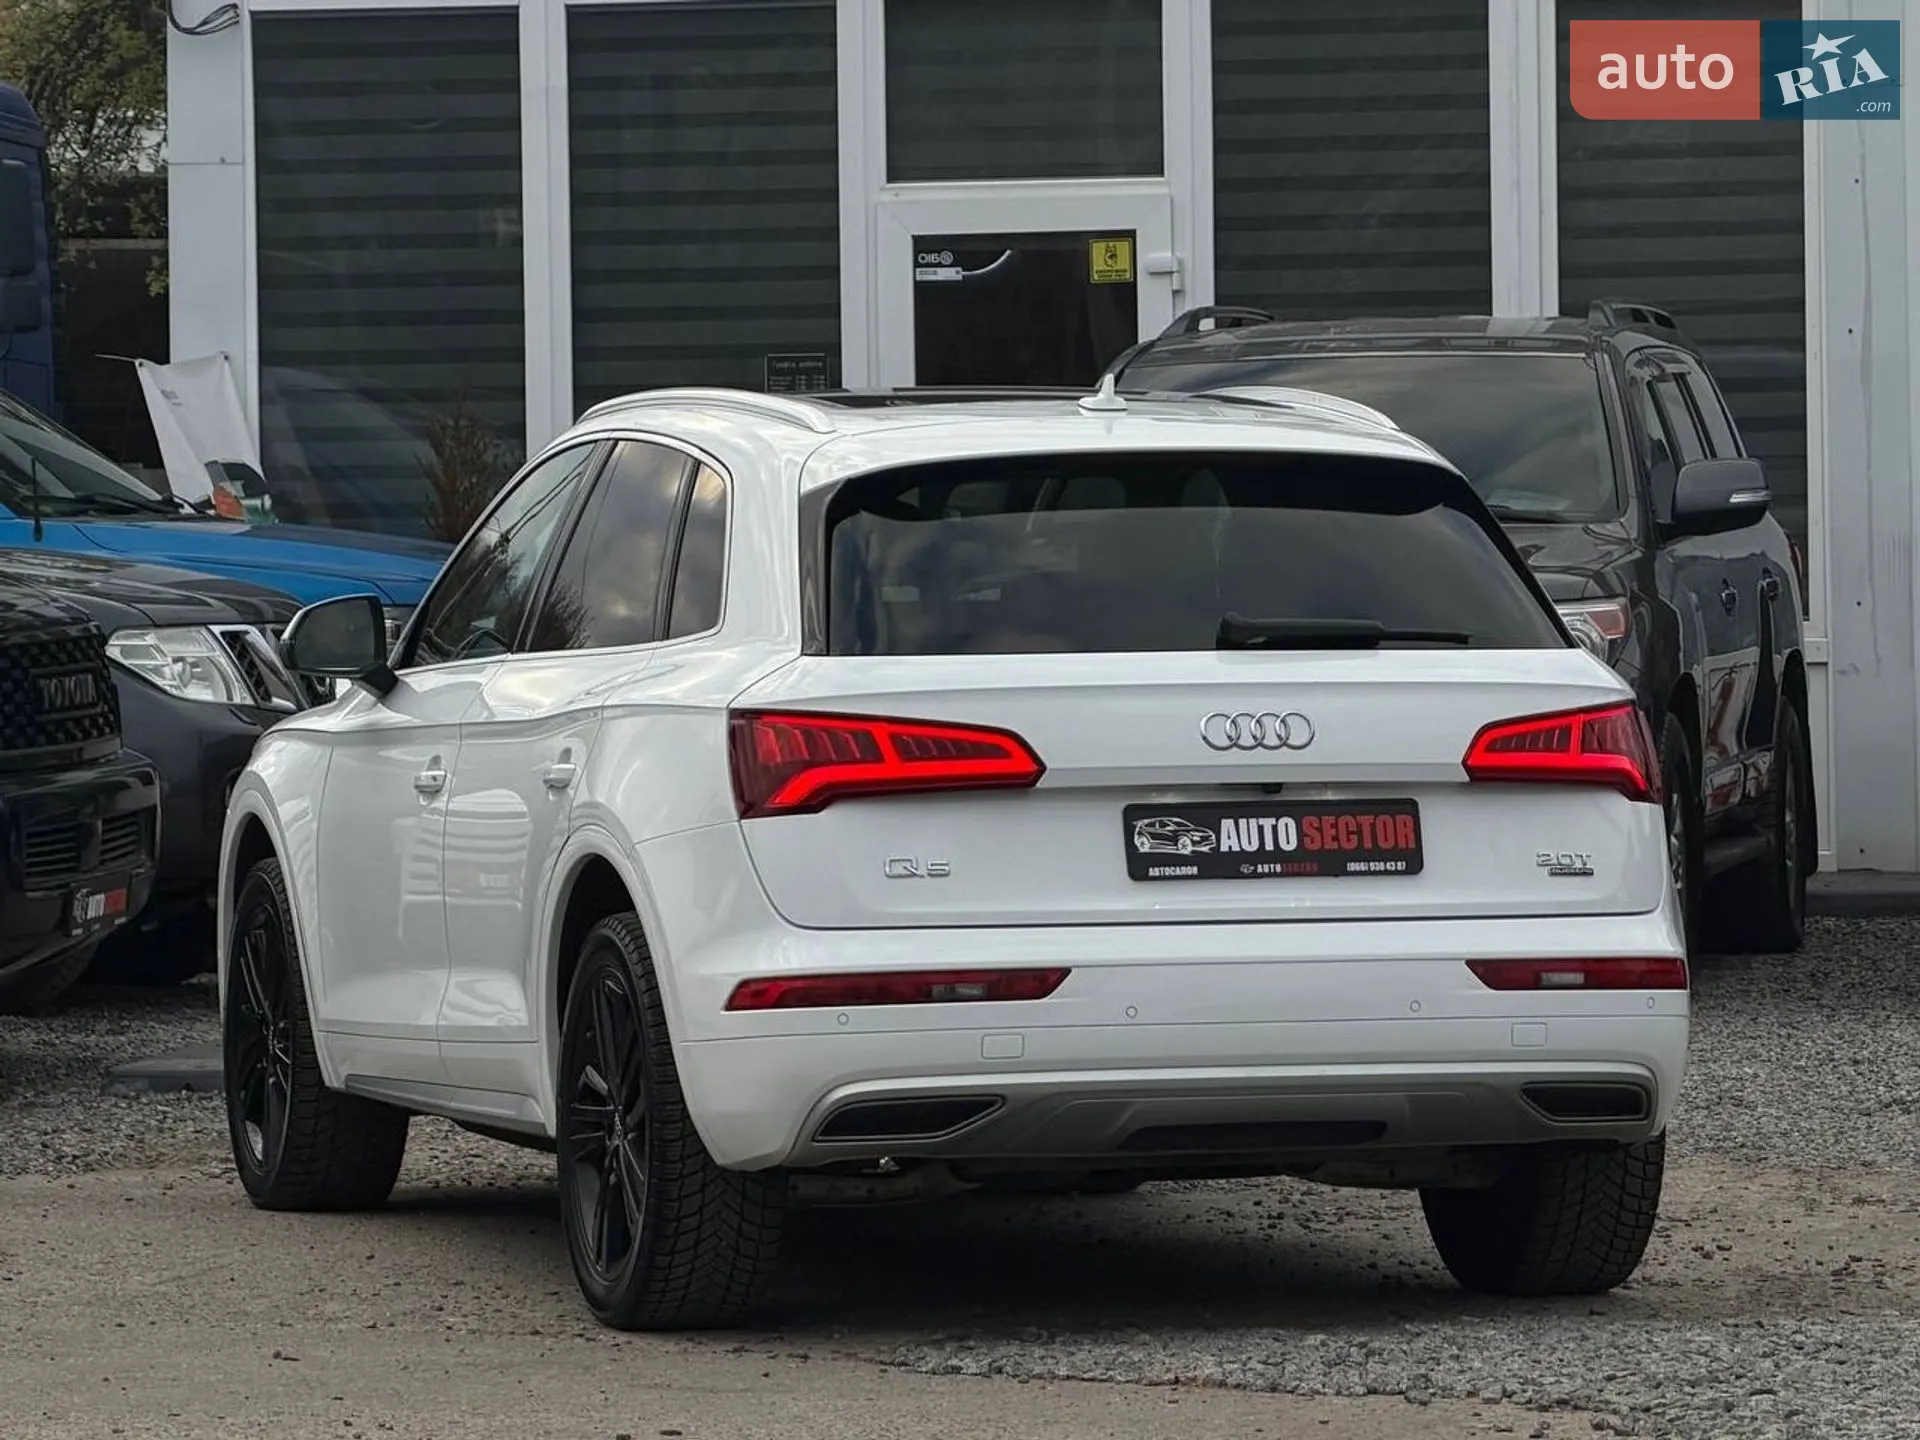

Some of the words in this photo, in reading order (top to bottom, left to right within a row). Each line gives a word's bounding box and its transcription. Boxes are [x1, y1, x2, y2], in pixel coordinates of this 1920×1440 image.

[1219, 816, 1297, 852] AUTO
[1301, 814, 1416, 851] SECTOR
[884, 857, 950, 878] Q5
